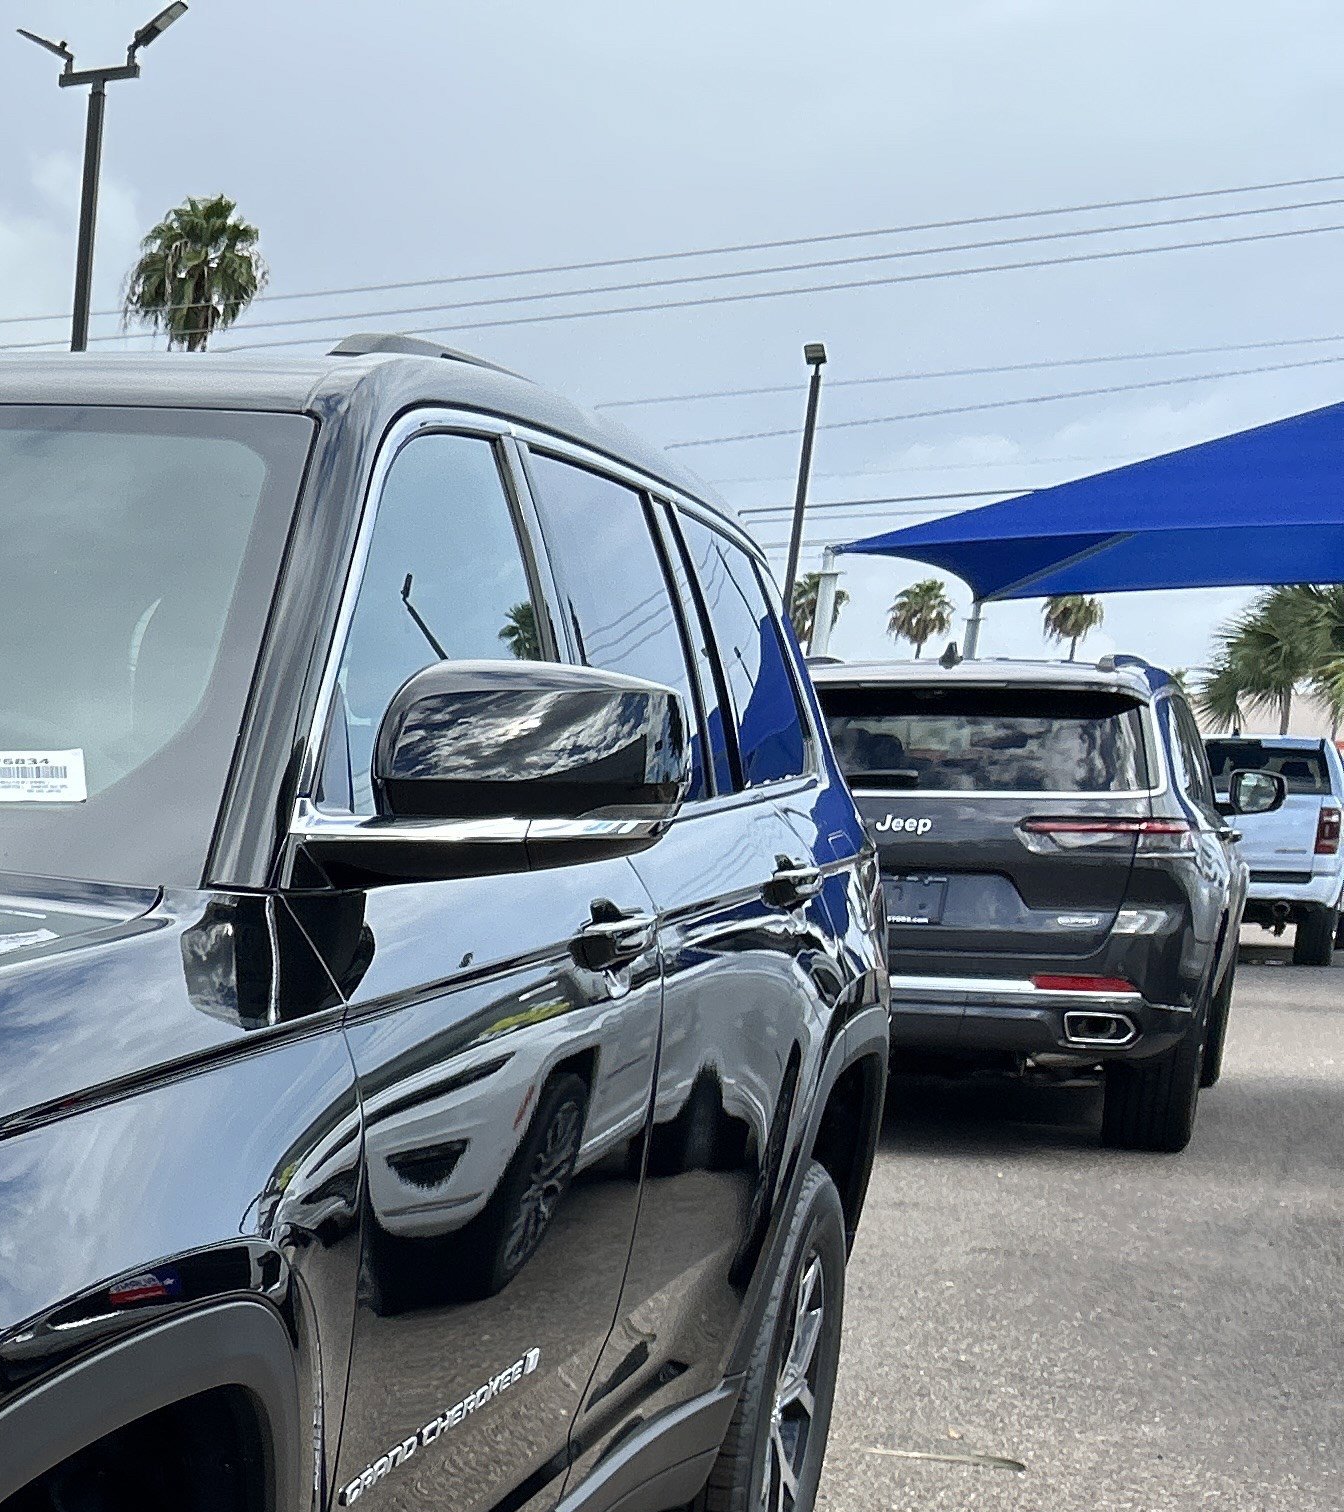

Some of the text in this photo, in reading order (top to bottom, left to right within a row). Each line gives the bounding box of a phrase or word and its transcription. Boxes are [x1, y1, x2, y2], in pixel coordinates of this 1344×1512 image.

[875, 814, 932, 835] Jeep
[344, 1358, 525, 1507] GRAND CHEROKEE
